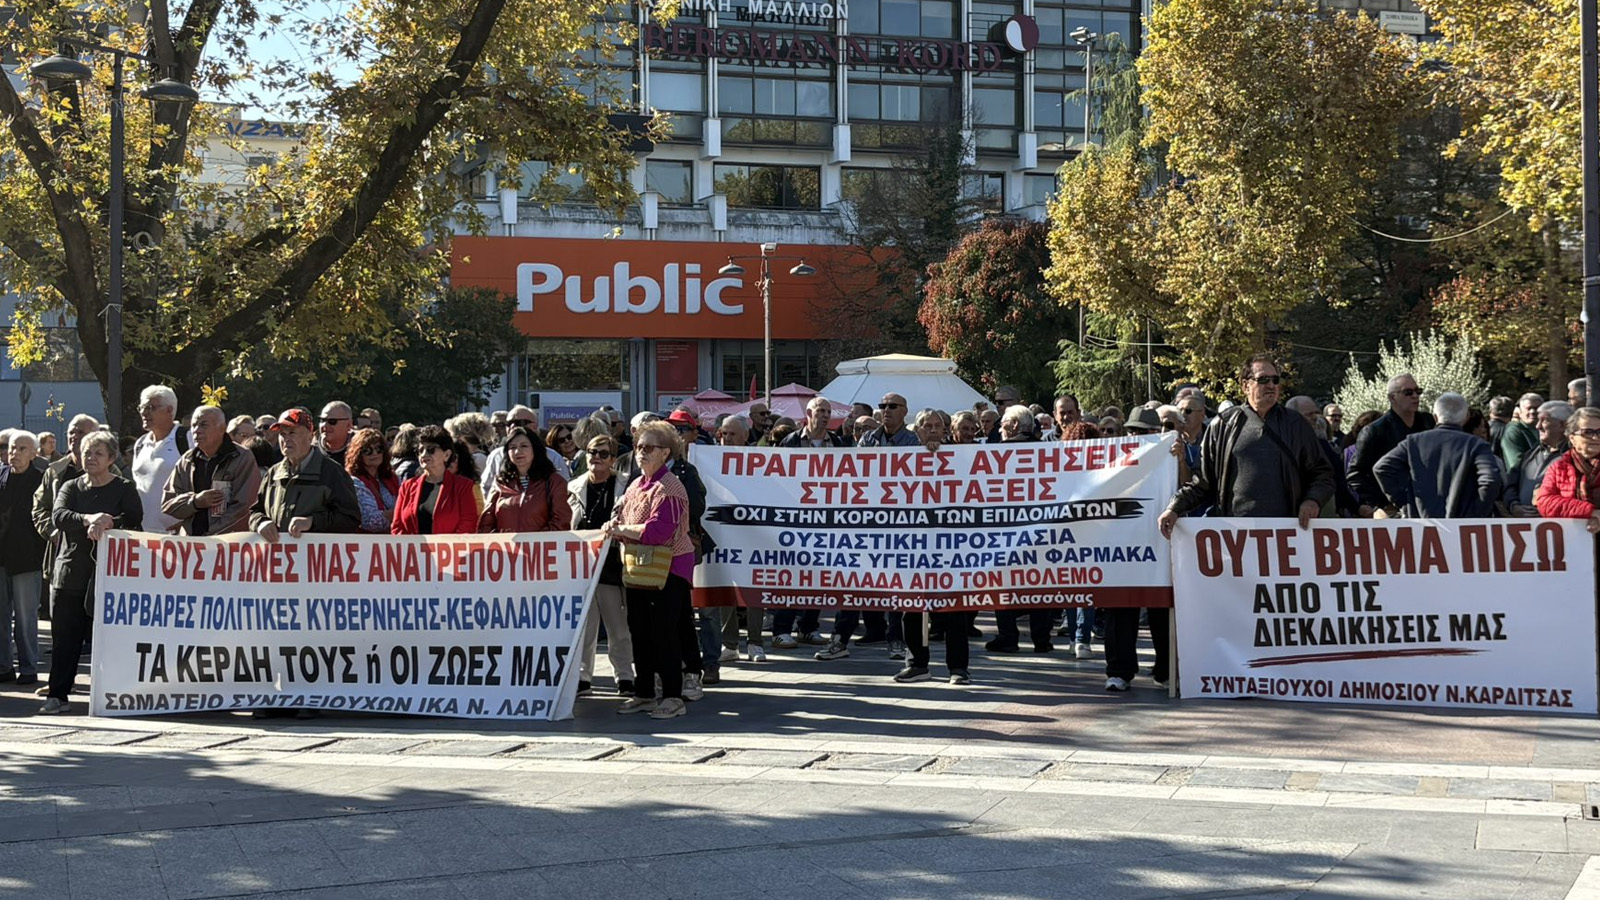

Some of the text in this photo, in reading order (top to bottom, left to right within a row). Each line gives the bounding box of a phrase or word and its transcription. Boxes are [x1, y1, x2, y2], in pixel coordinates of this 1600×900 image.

[643, 24, 1001, 71] BERGMANN KORD
[516, 261, 745, 316] Public
[721, 442, 1140, 478] ΠΡΑΓΜΑΤΙΚΕΣ ΑΥΞΗΣΕΙΣ
[800, 477, 1057, 505] ΣΤΙΣ ΣΥΝΤΑΞΕΙΣ
[733, 501, 1117, 525] ΟΧΙ ΣΤΗΝ ΚΟΡΟΙΔΙΑ ΤΩΝ ΕΠΙΔΟΜΑΤΩΝ
[778, 528, 1076, 550] ΟΥΣΙΑΣΤΙΚΗ ΠΡΟΣΤΑΣΙΑ
[1195, 521, 1567, 577] ΟΥΤΕ ΒΗΜΑ ΠΙΣΩ
[106, 538, 140, 577] ΜΕ
[147, 540, 206, 580] ΤΟΥΣ
[211, 542, 299, 583] ΑΓΩΝΕΣ
[307, 543, 360, 583] ΜΑΣ
[367, 541, 558, 583] ΑΝΑΤΡΕΠΟΥΜΕ
[705, 546, 1157, 569] ΤΗΣ ΔΗΜΟΣΙΑΣ ΥΓΕΙΑΣ-ΔΩΡΕΑΝ ΦΑΡΜΑΚΑ
[752, 566, 1104, 590] ΕΞΩ Η ΕΛΛΑΔΑ ΑΠΟ ΤΟΝ ΠΟΛΕΜΟ
[103, 591, 197, 629] ΒΑΡΒΑΡΕΣ
[200, 596, 300, 631] ΠΟΛΙΤΙΚΕΣ
[761, 592, 1094, 611] Σωματείο Συνταξιούχων ΙΚΑ Ελασσόνας
[1253, 581, 1382, 614] ΑΠΟ ΤΙΣ
[1253, 613, 1507, 647] ΔΙΕΚΔΙΚΗΣΕΙΣ ΜΑΣ
[136, 642, 570, 687] ΤΑ ΚΕΡΔΗ ΤΟΥΣ ή ΟΙ ΖΩΕΣ ΜΑΣ
[105, 693, 224, 711] ΣΩΜΑΤΕΙΟ
[229, 694, 412, 712] ΣΥΝΤΑΞΙΟΥΧΩΝ
[417, 697, 458, 715] ΙΚΑ
[466, 699, 489, 715] Ν.
[1200, 676, 1574, 708] ΣΥΝΤΑΞΙΟΥΧΟΙ ΔΗΜΟΣΙΟΥ Ν.ΚΑΡΔΙΤΣΑΣ
